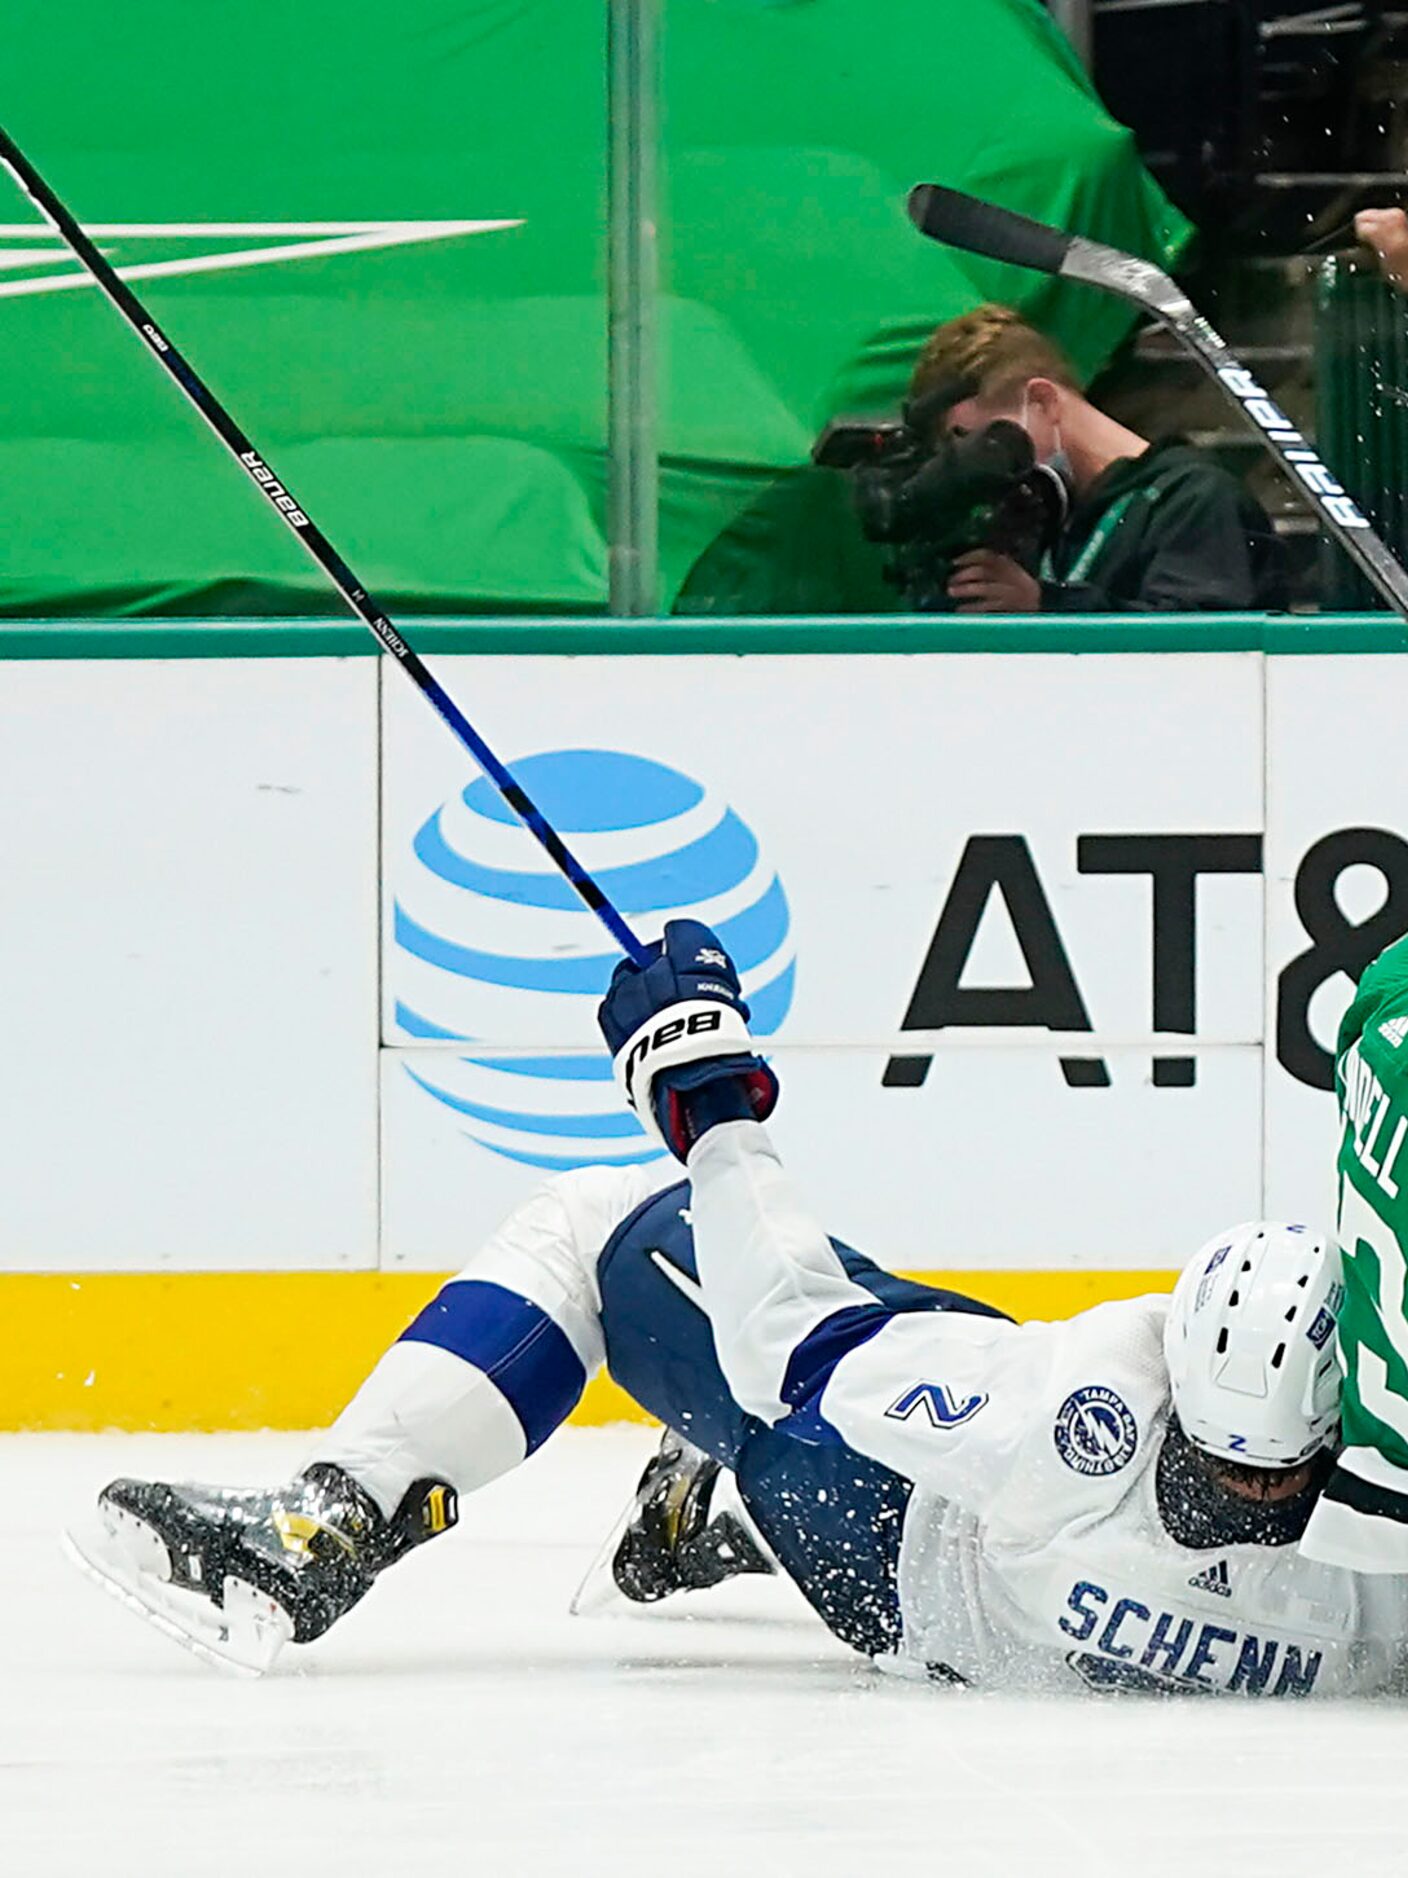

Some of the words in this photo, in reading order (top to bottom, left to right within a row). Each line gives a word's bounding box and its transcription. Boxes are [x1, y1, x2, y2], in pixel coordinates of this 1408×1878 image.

[241, 451, 309, 527] BAUER
[883, 1378, 989, 1430] 2
[1082, 1388, 1123, 1413] TAMPA
[1122, 1413, 1136, 1442] BAY
[1228, 1434, 1247, 1452] 2
[1187, 1576, 1233, 1599] adidas
[1057, 1580, 1323, 1699] SCHENN
